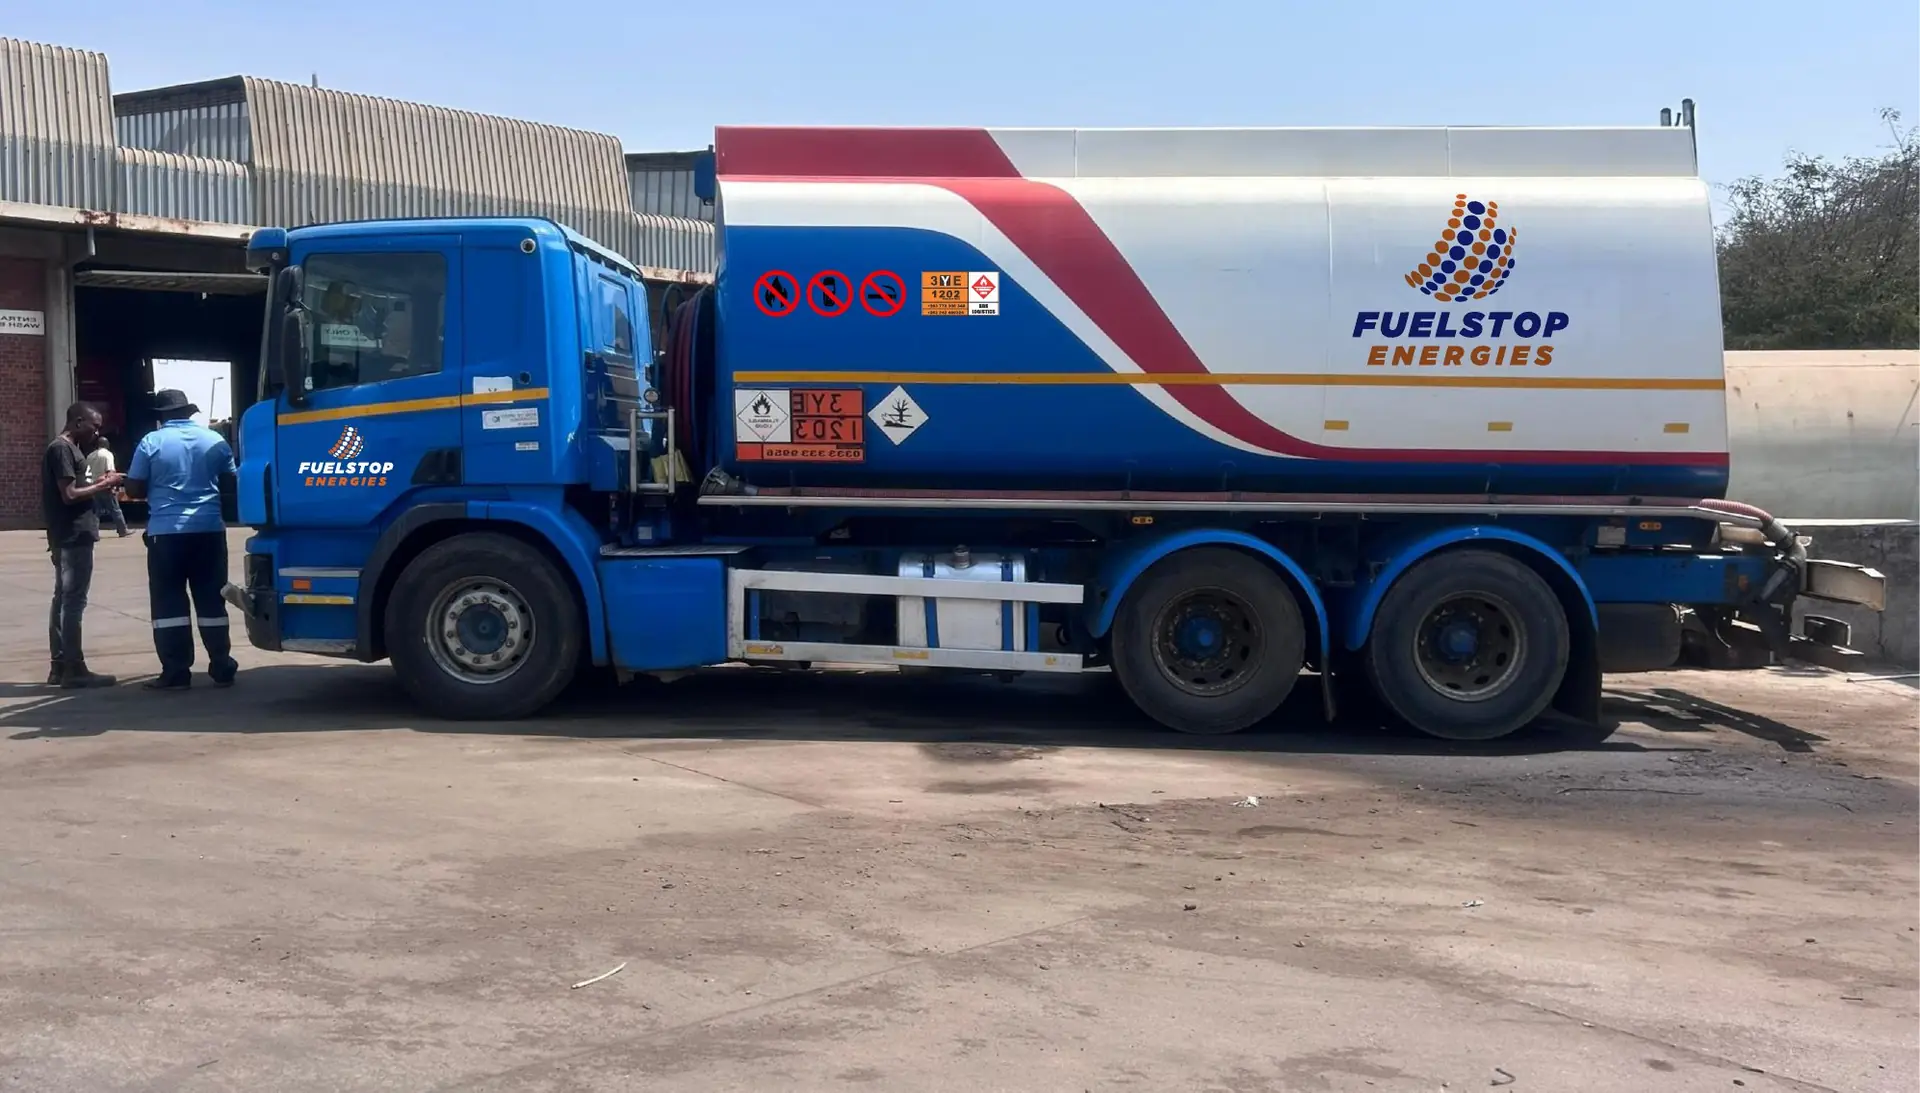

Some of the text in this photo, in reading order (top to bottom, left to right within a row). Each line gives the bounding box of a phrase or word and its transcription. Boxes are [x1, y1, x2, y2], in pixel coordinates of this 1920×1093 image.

[930, 276, 962, 286] 3YE
[1352, 311, 1569, 338] FUELSTOP
[1366, 345, 1555, 366] ENERGIES
[298, 462, 394, 474] FUELSTOP
[305, 477, 388, 487] ENERGIES
